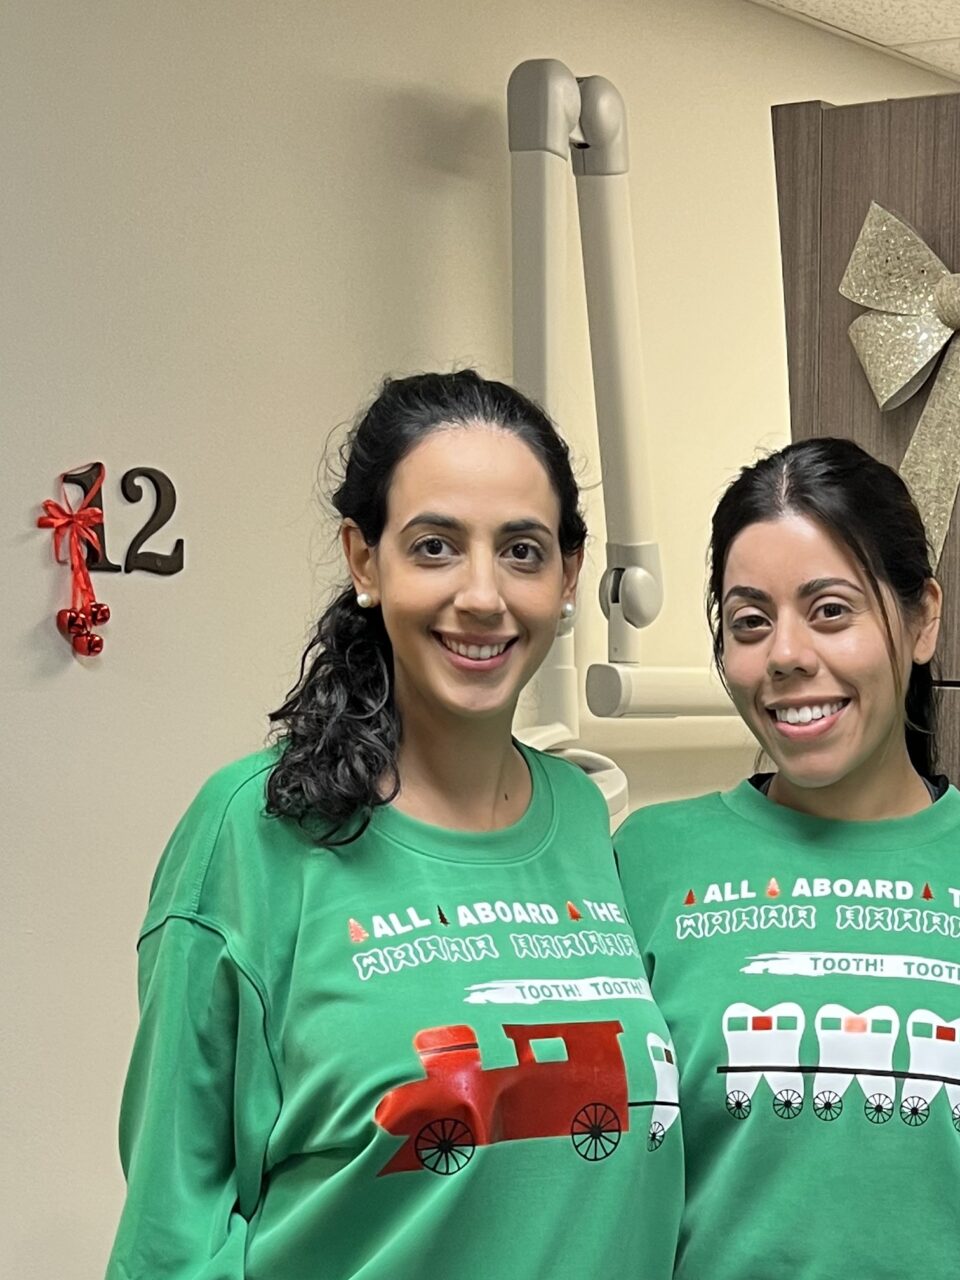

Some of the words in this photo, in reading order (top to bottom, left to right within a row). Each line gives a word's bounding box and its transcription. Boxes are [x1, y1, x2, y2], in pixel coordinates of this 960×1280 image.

[63, 462, 184, 576] 12
[704, 881, 757, 903] ALL
[792, 878, 913, 900] ABOARD
[372, 907, 431, 938] ALL
[457, 901, 559, 927] ABOARD
[583, 899, 625, 924] THE
[679, 906, 813, 935] MOLAR
[356, 937, 495, 975] MOLAR
[810, 957, 884, 972] TOOTH!
[516, 984, 582, 1000] TOOTH!
[590, 981, 643, 998] TOOTH!
